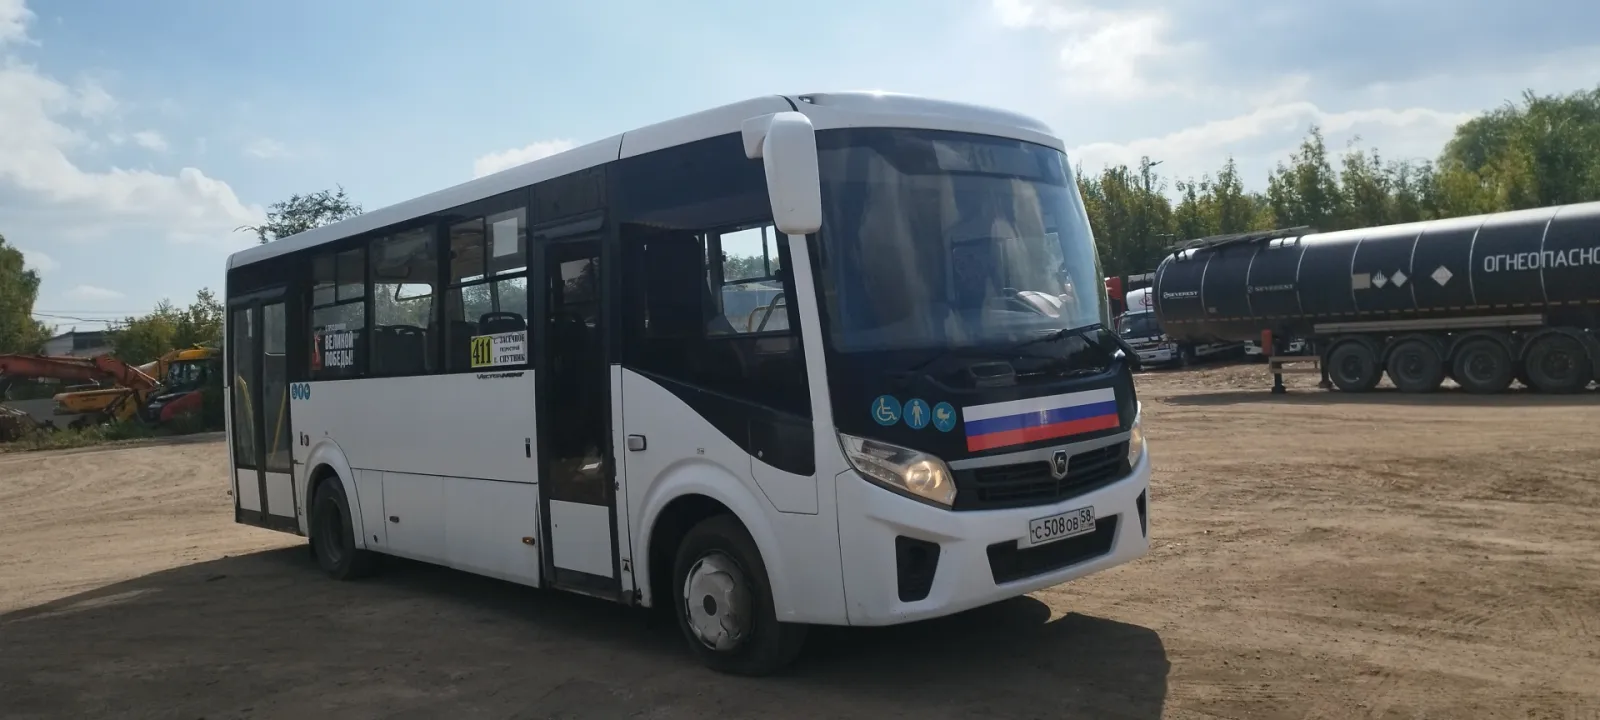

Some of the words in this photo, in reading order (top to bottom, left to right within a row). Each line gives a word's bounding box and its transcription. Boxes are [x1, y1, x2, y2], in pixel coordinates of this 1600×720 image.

[325, 331, 354, 350] ВЕЛИКОЙ
[325, 350, 354, 368] ПОБЕДЫ!
[473, 338, 491, 365] 411
[1080, 509, 1091, 523] 58
